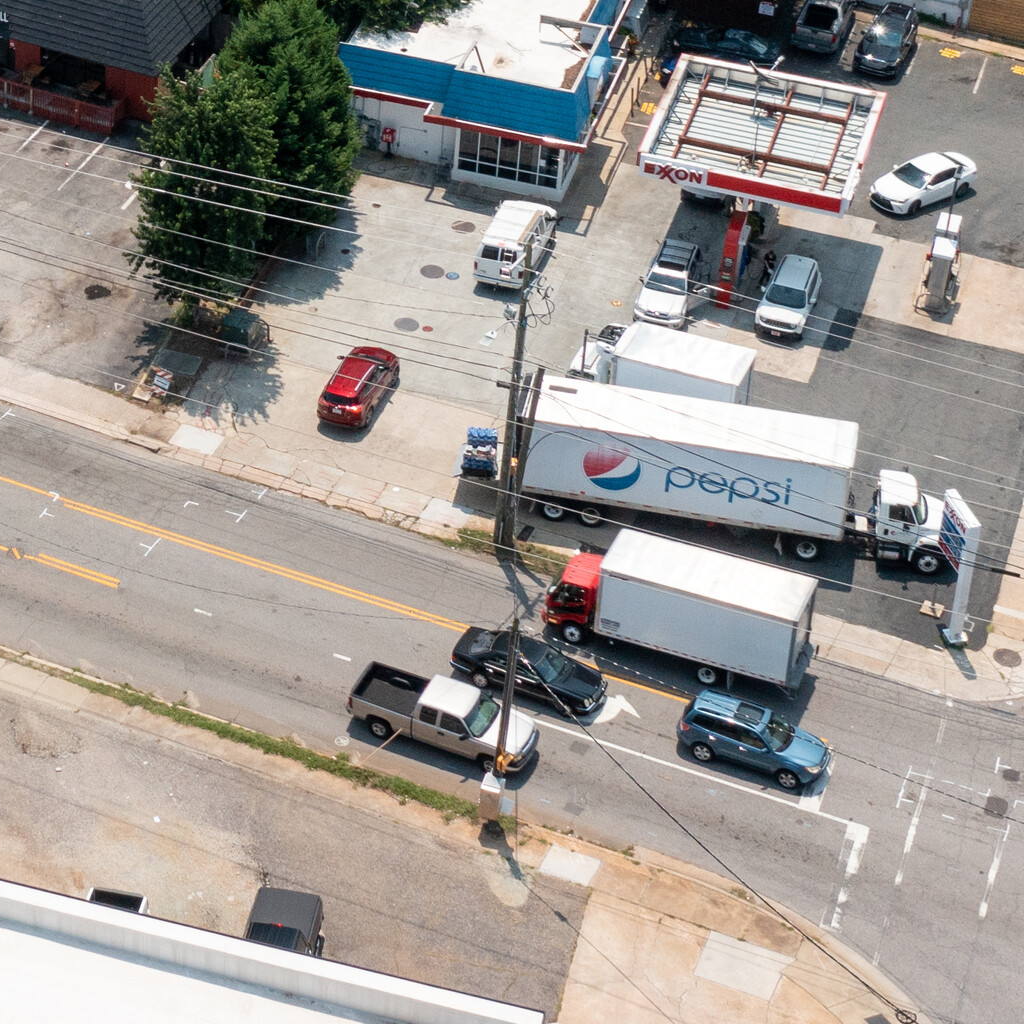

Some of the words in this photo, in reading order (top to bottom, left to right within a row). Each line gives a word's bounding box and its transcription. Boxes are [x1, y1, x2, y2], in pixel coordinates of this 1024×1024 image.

[644, 161, 704, 184] EXXON
[664, 466, 792, 505] pepsi
[945, 500, 967, 535] EXXON
